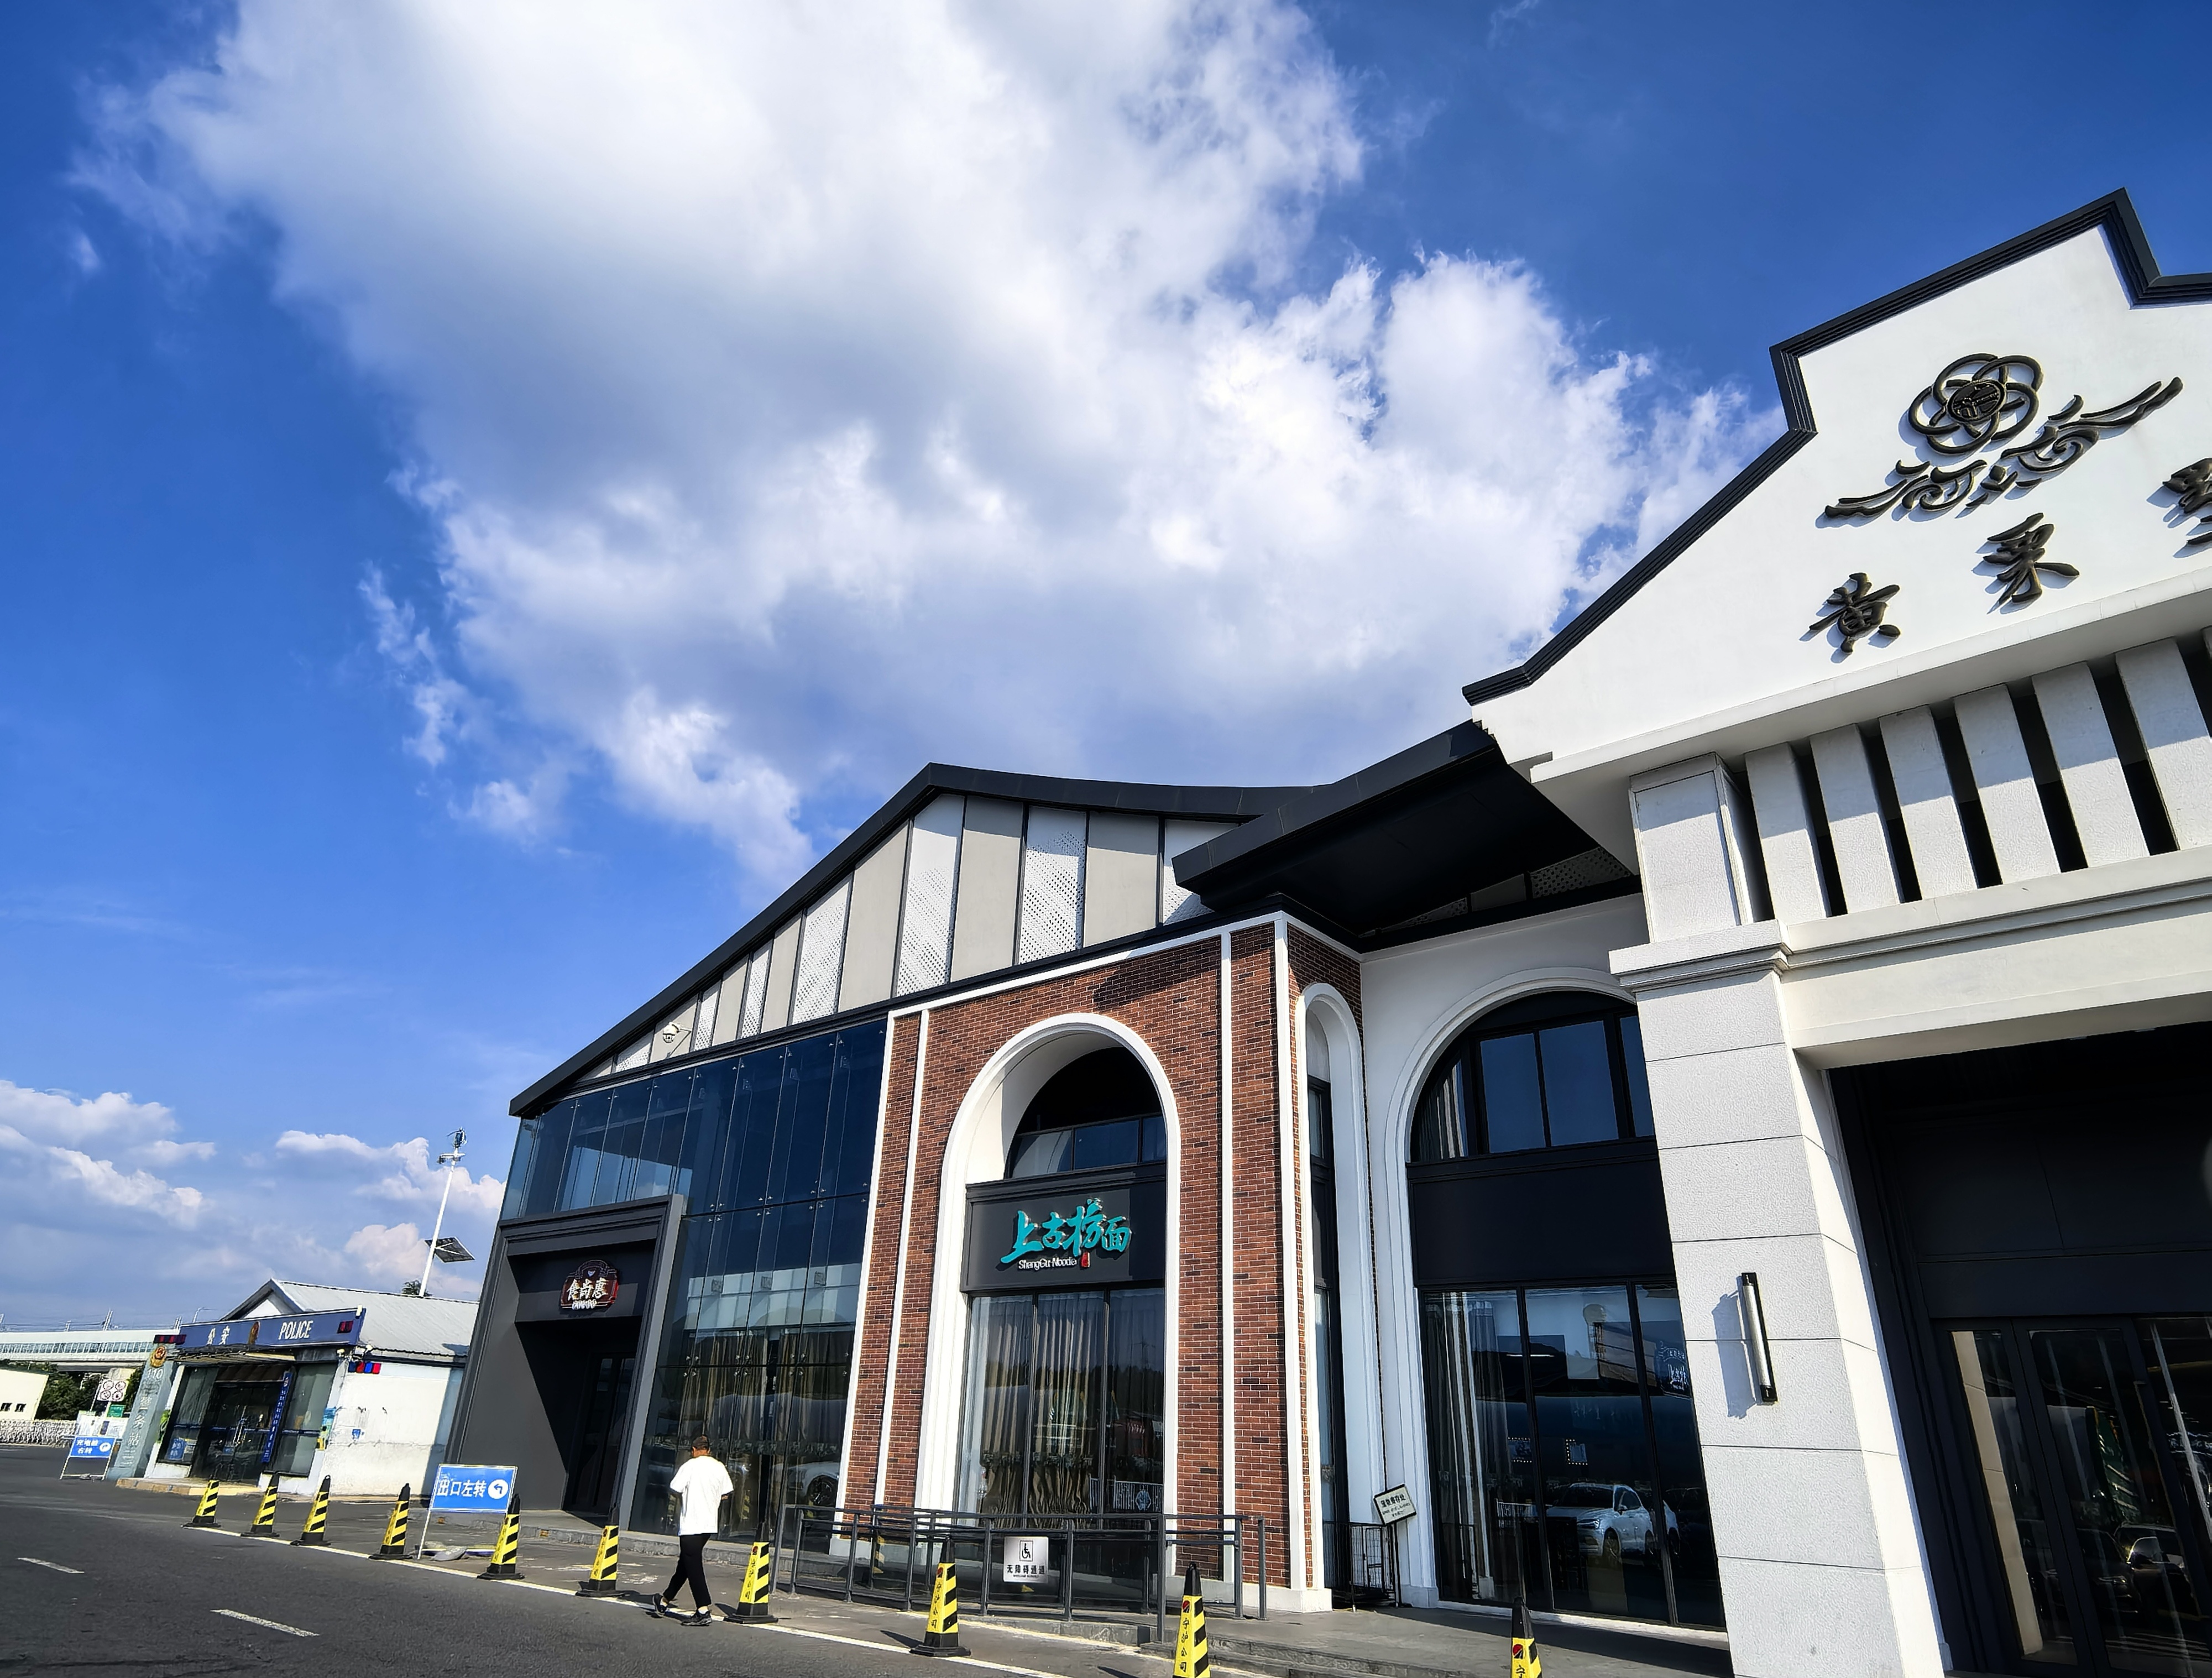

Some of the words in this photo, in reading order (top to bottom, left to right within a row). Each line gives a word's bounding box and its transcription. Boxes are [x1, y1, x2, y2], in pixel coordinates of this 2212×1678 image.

[207, 1325, 231, 1345] 公安
[278, 1320, 314, 1340] POLICE
[146, 1368, 164, 1380] 110
[436, 1478, 487, 1498] 出口左转
[1007, 1564, 1045, 1574] 无障碍通道
